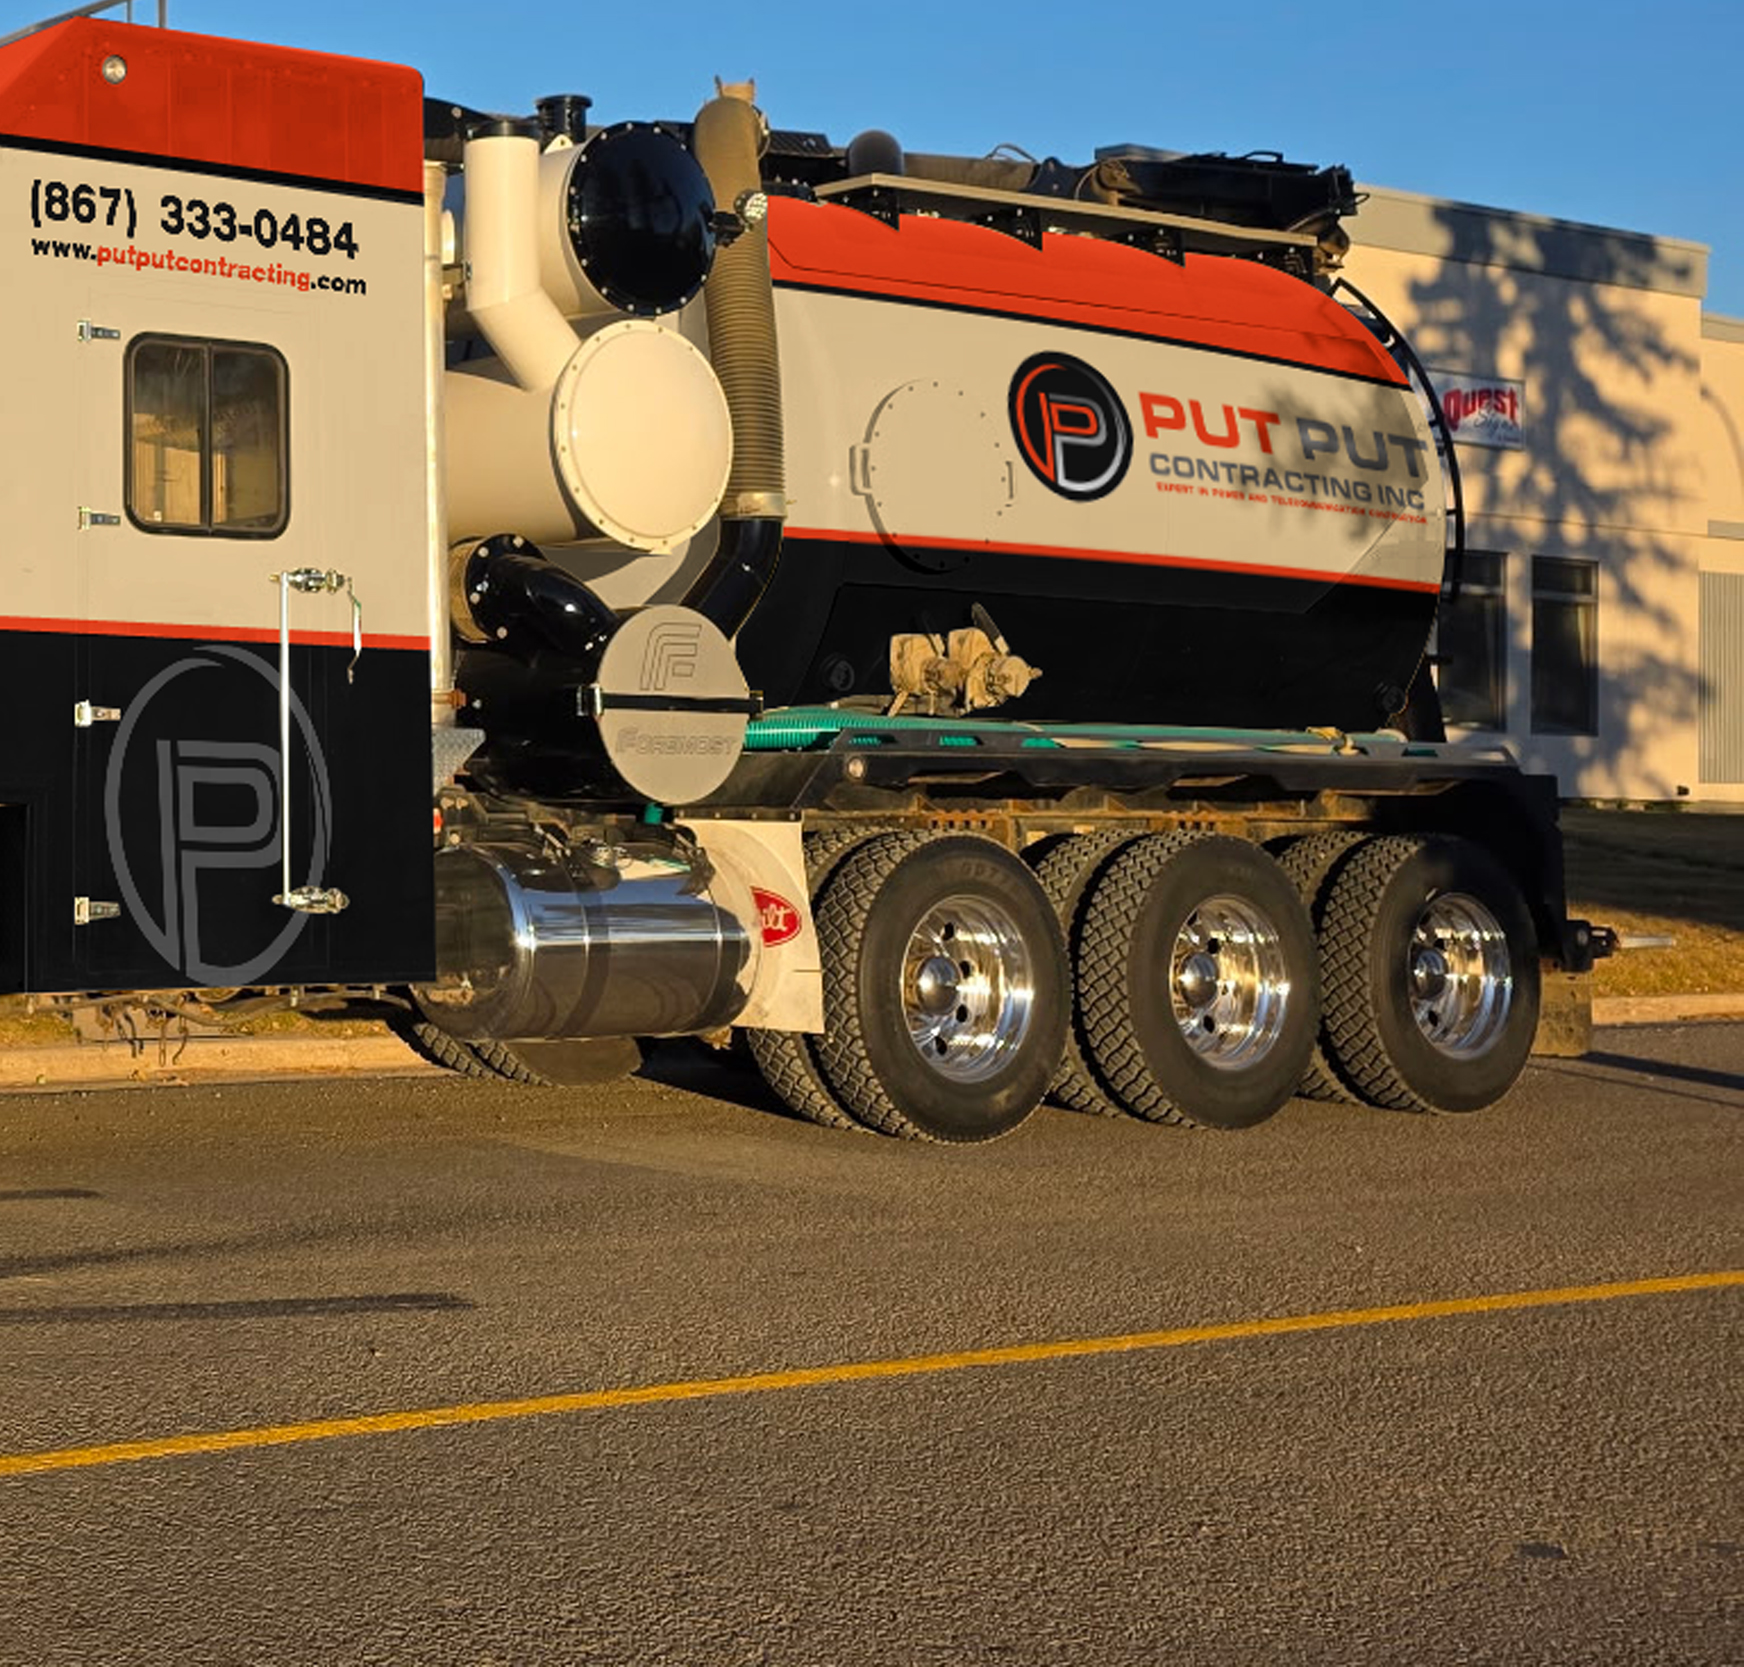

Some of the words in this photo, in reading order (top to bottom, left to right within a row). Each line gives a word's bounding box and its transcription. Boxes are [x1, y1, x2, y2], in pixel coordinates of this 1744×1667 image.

[30, 178, 137, 239] (867)
[160, 194, 360, 260] 333-0484
[31, 238, 367, 296] www.putputcontracting.com
[1138, 391, 1281, 455] PUT
[1296, 416, 1428, 479] PUT
[1149, 452, 1372, 506] CONTRACTING
[1377, 482, 1426, 511] INC
